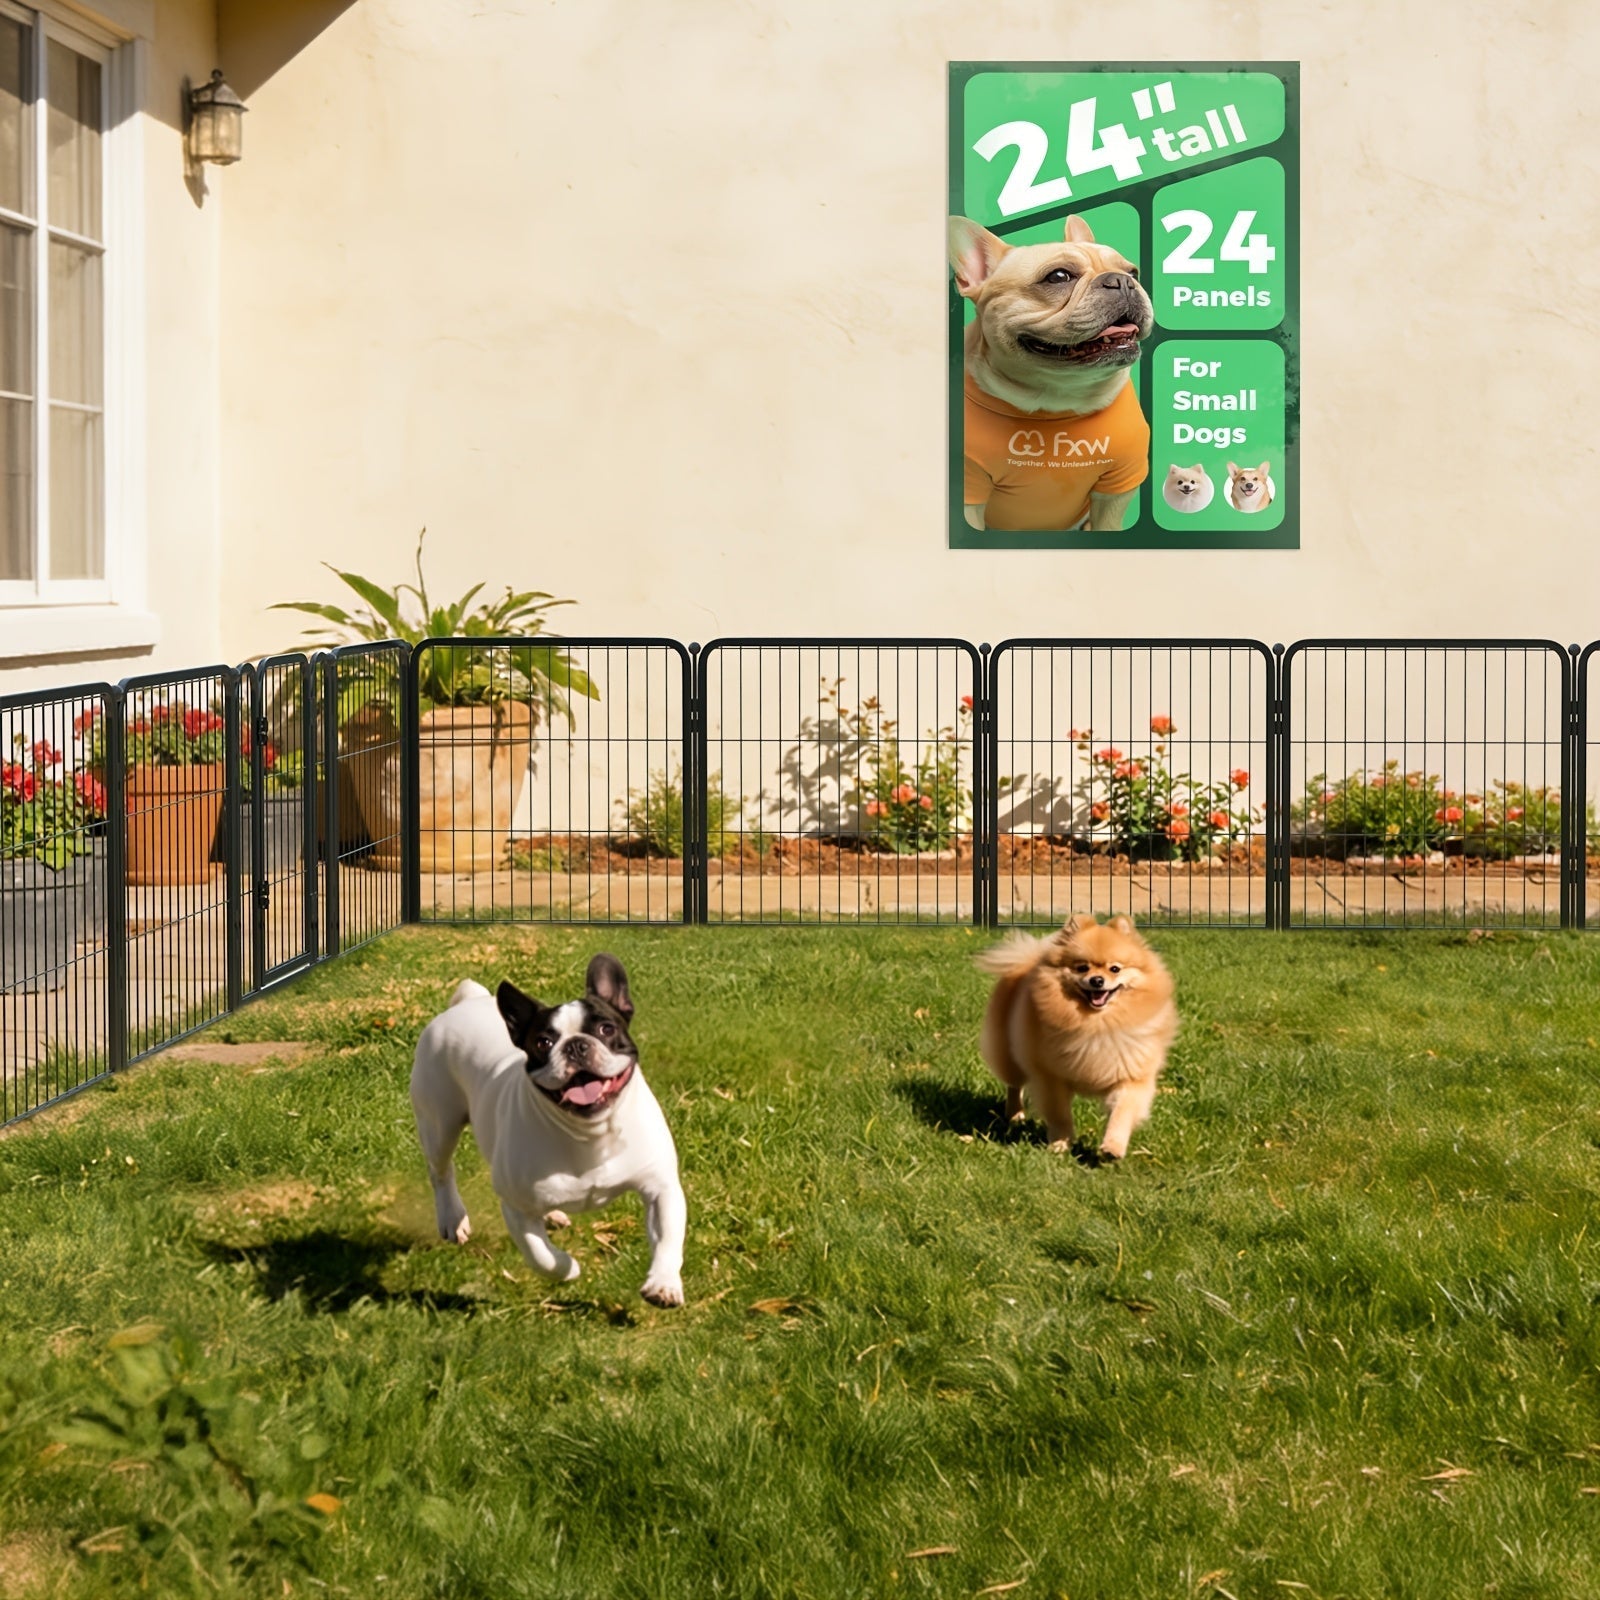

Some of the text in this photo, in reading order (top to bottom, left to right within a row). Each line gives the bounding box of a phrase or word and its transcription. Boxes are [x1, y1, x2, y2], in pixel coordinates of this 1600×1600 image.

[972, 81, 1248, 217] 24" tall
[1160, 209, 1276, 275] 24
[1173, 285, 1271, 307] Panels
[1172, 357, 1222, 378] For
[1172, 389, 1257, 411] Small
[1172, 423, 1247, 449] Dogs
